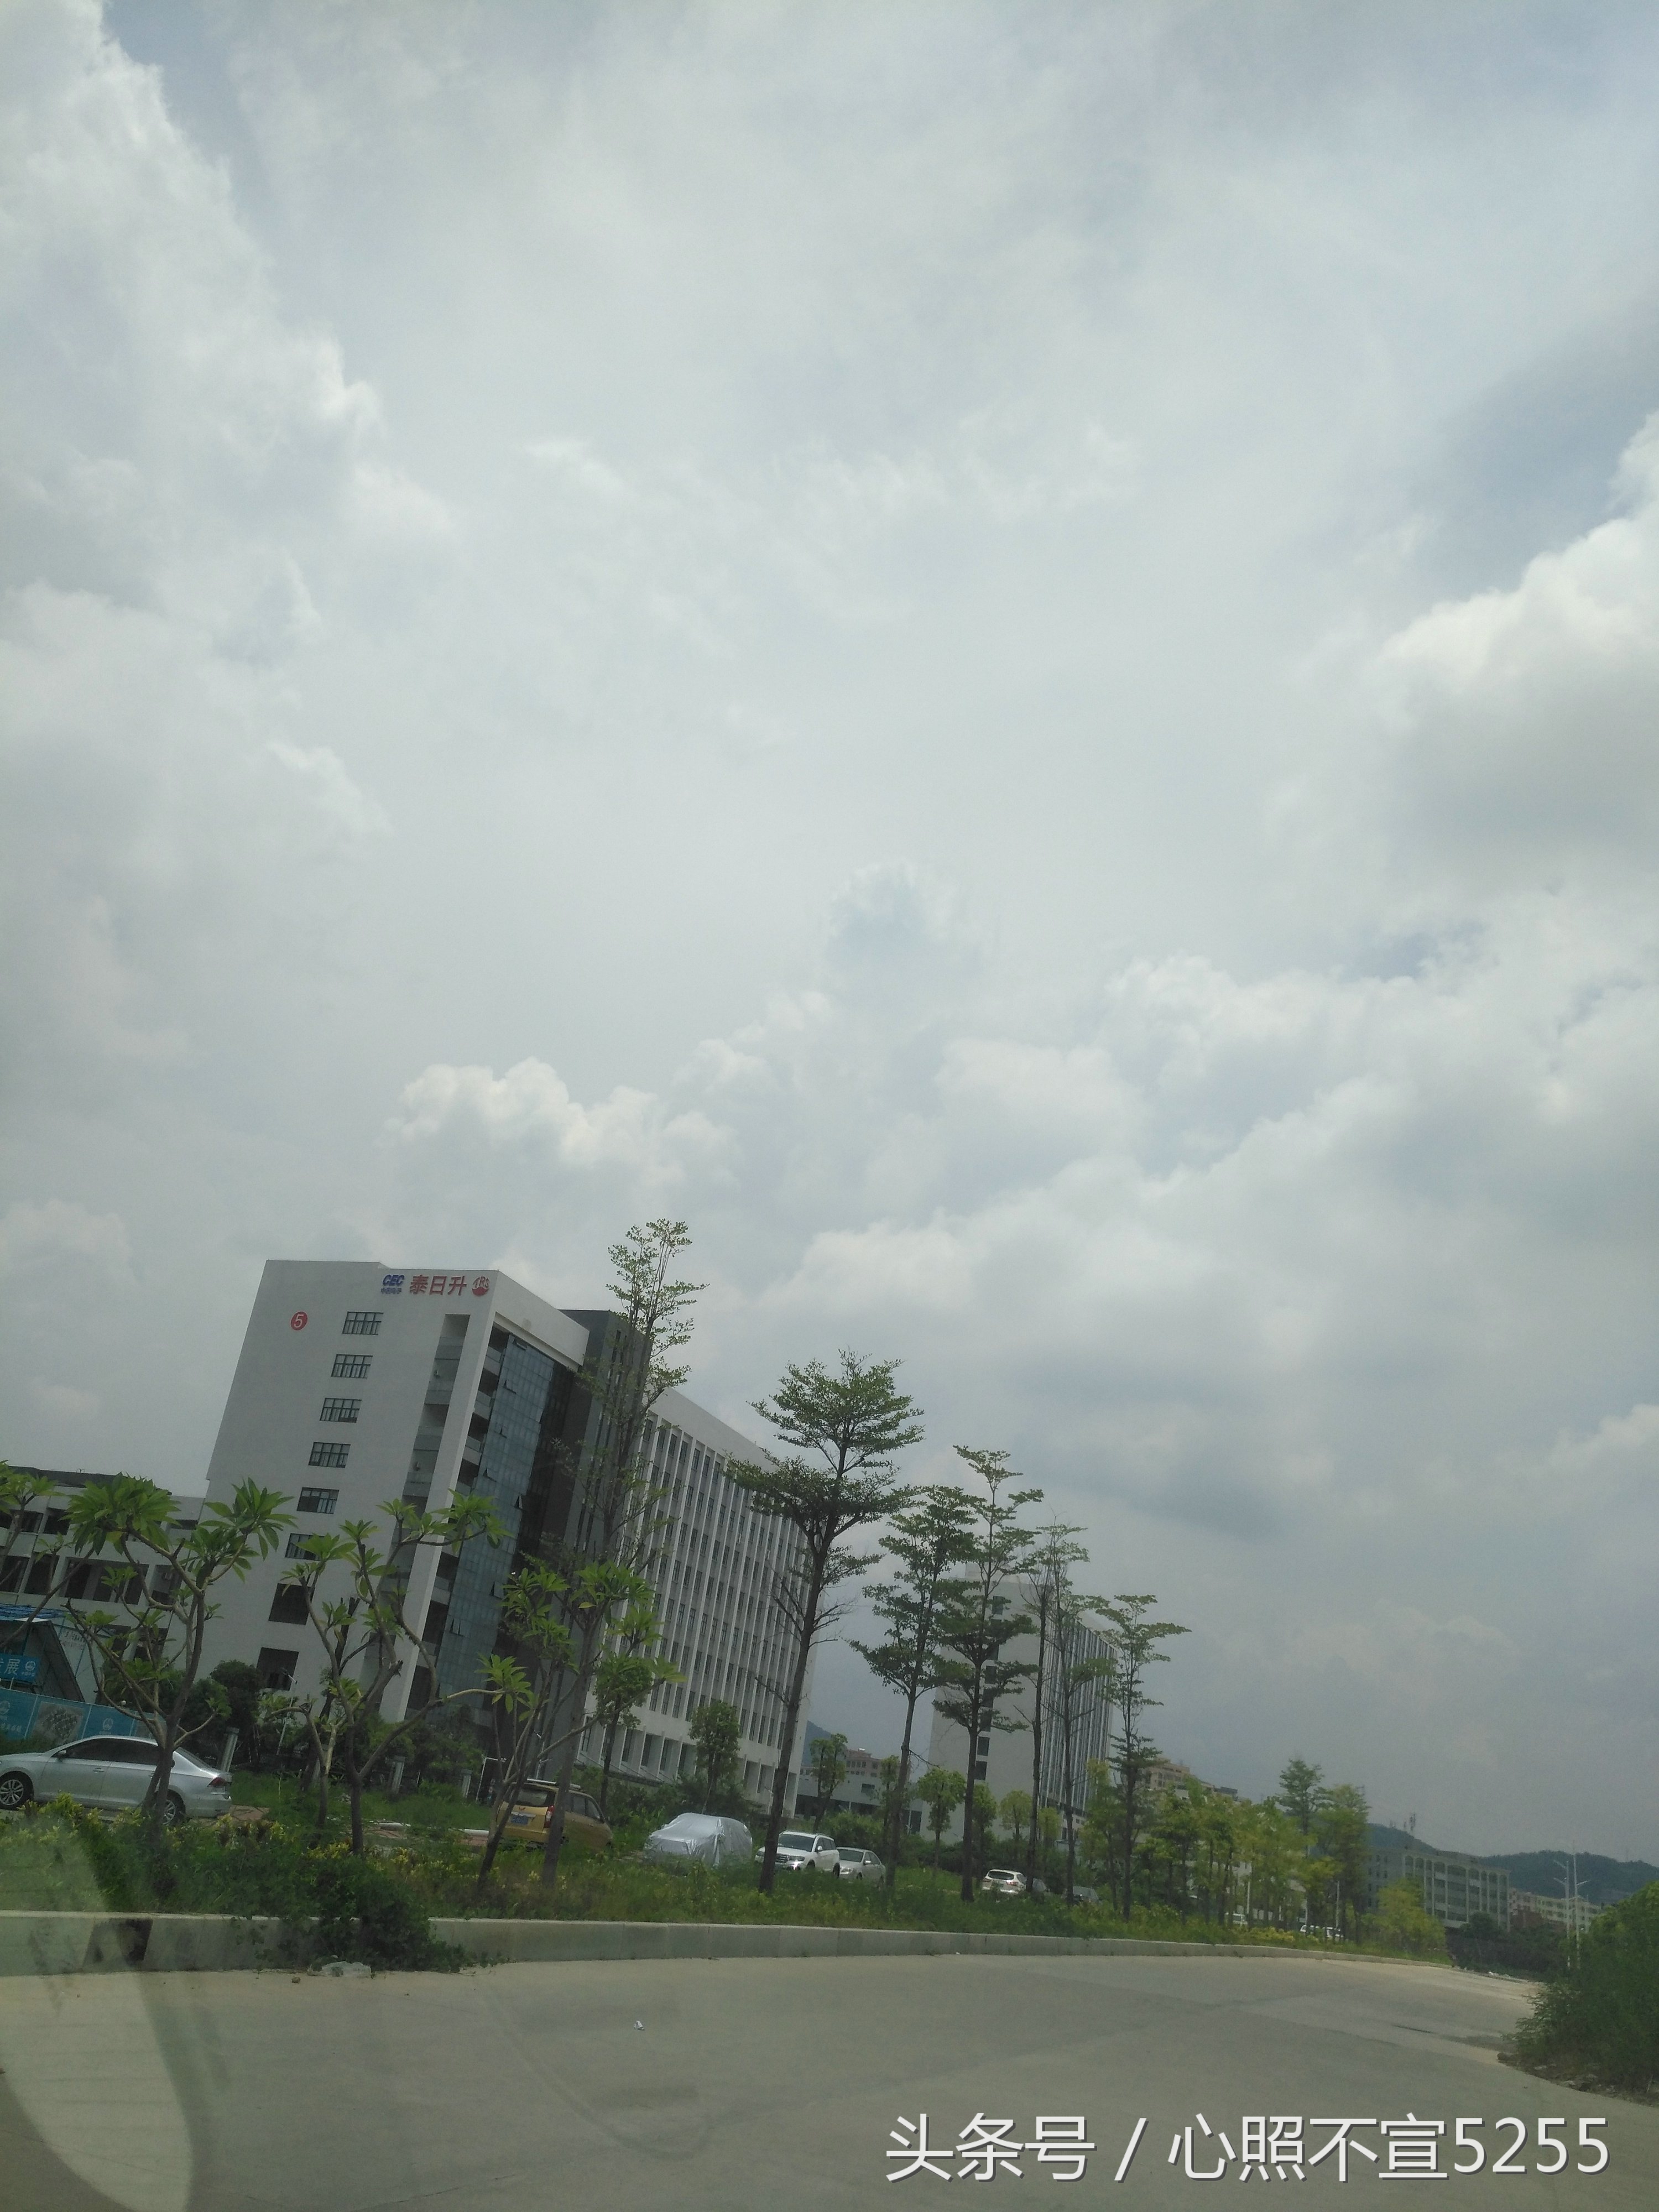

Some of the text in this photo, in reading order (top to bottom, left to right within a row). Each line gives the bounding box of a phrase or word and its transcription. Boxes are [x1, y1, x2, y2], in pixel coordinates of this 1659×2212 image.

[382, 1274, 404, 1285] CEC
[409, 1274, 467, 1296] 泰日升
[473, 1276, 490, 1288] TRS
[294, 1314, 304, 1328] 5
